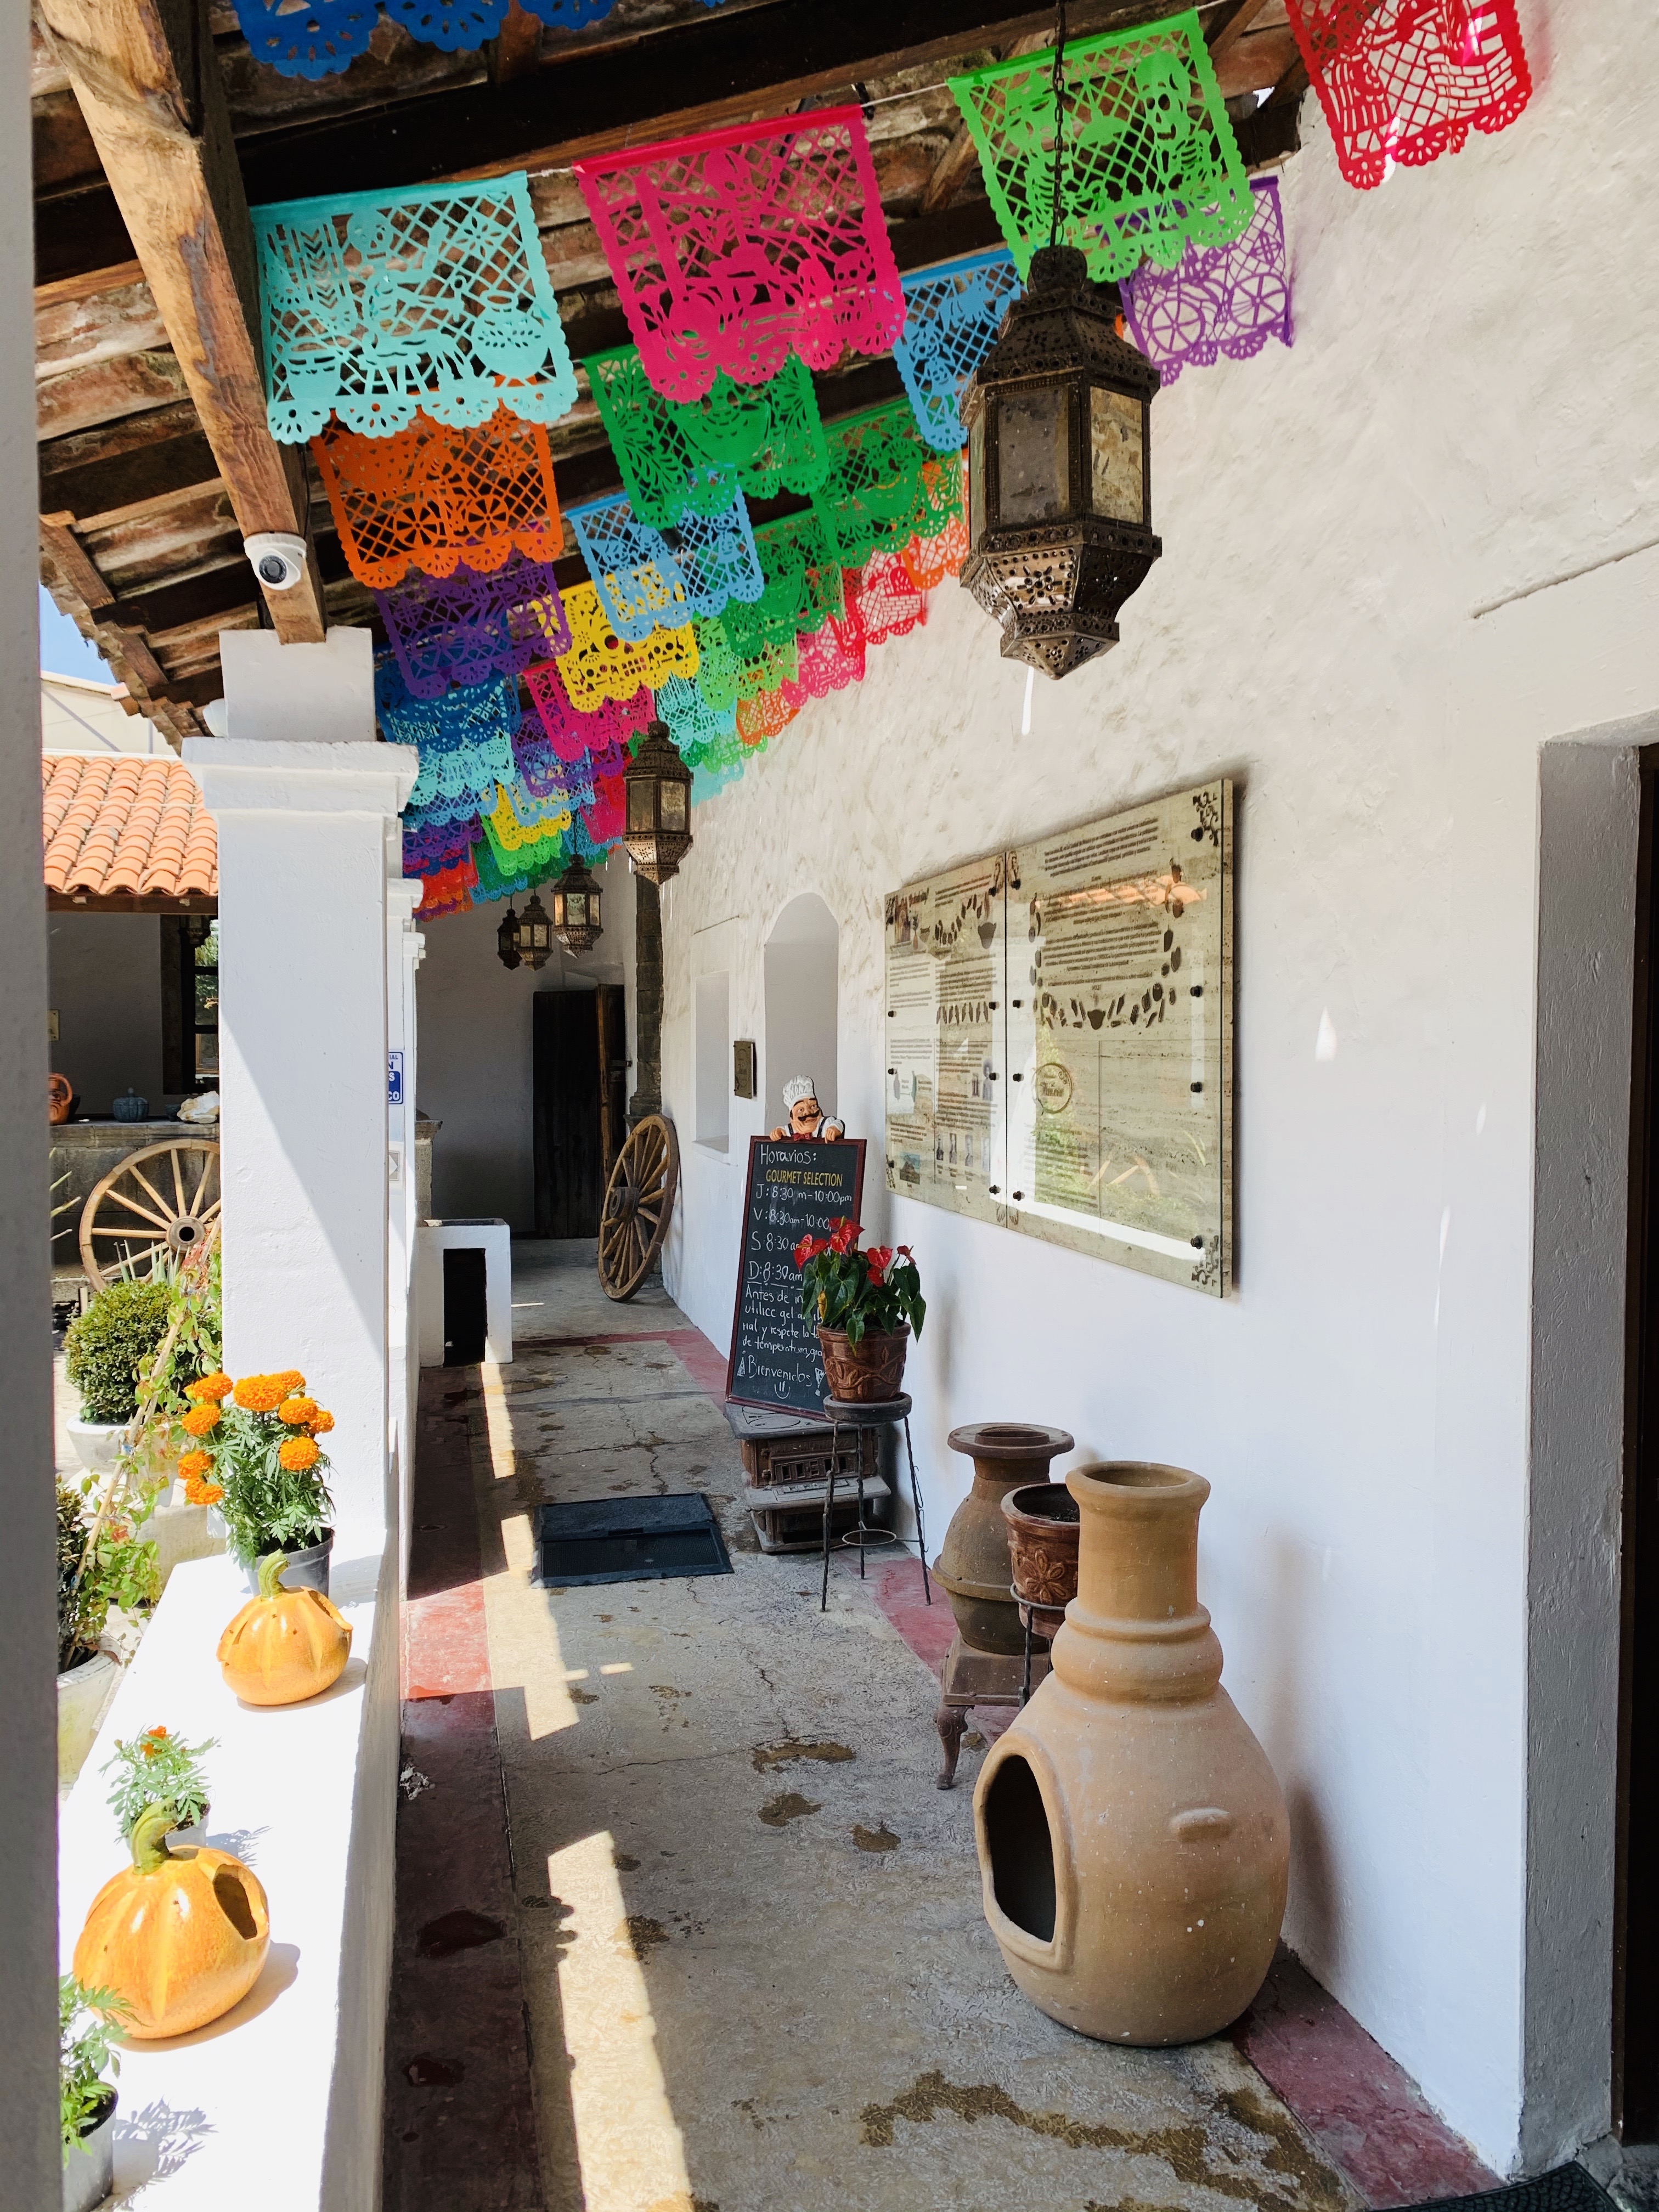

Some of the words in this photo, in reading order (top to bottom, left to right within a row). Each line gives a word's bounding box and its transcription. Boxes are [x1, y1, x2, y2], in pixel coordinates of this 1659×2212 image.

[389, 1072, 395, 1082] S
[388, 1091, 400, 1101] CO
[760, 1144, 816, 1165] Horarios:
[766, 1169, 802, 1184] GOURMET
[803, 1171, 843, 1187] SELECTION
[746, 1284, 775, 1302] Antes
[777, 1289, 789, 1304] de
[795, 1295, 804, 1304] in
[780, 1306, 794, 1327] gel
[742, 1318, 758, 1332] rial
[762, 1327, 768, 1340] y
[770, 1323, 799, 1340] respete
[803, 1325, 809, 1338] la
[742, 1335, 752, 1347] de
